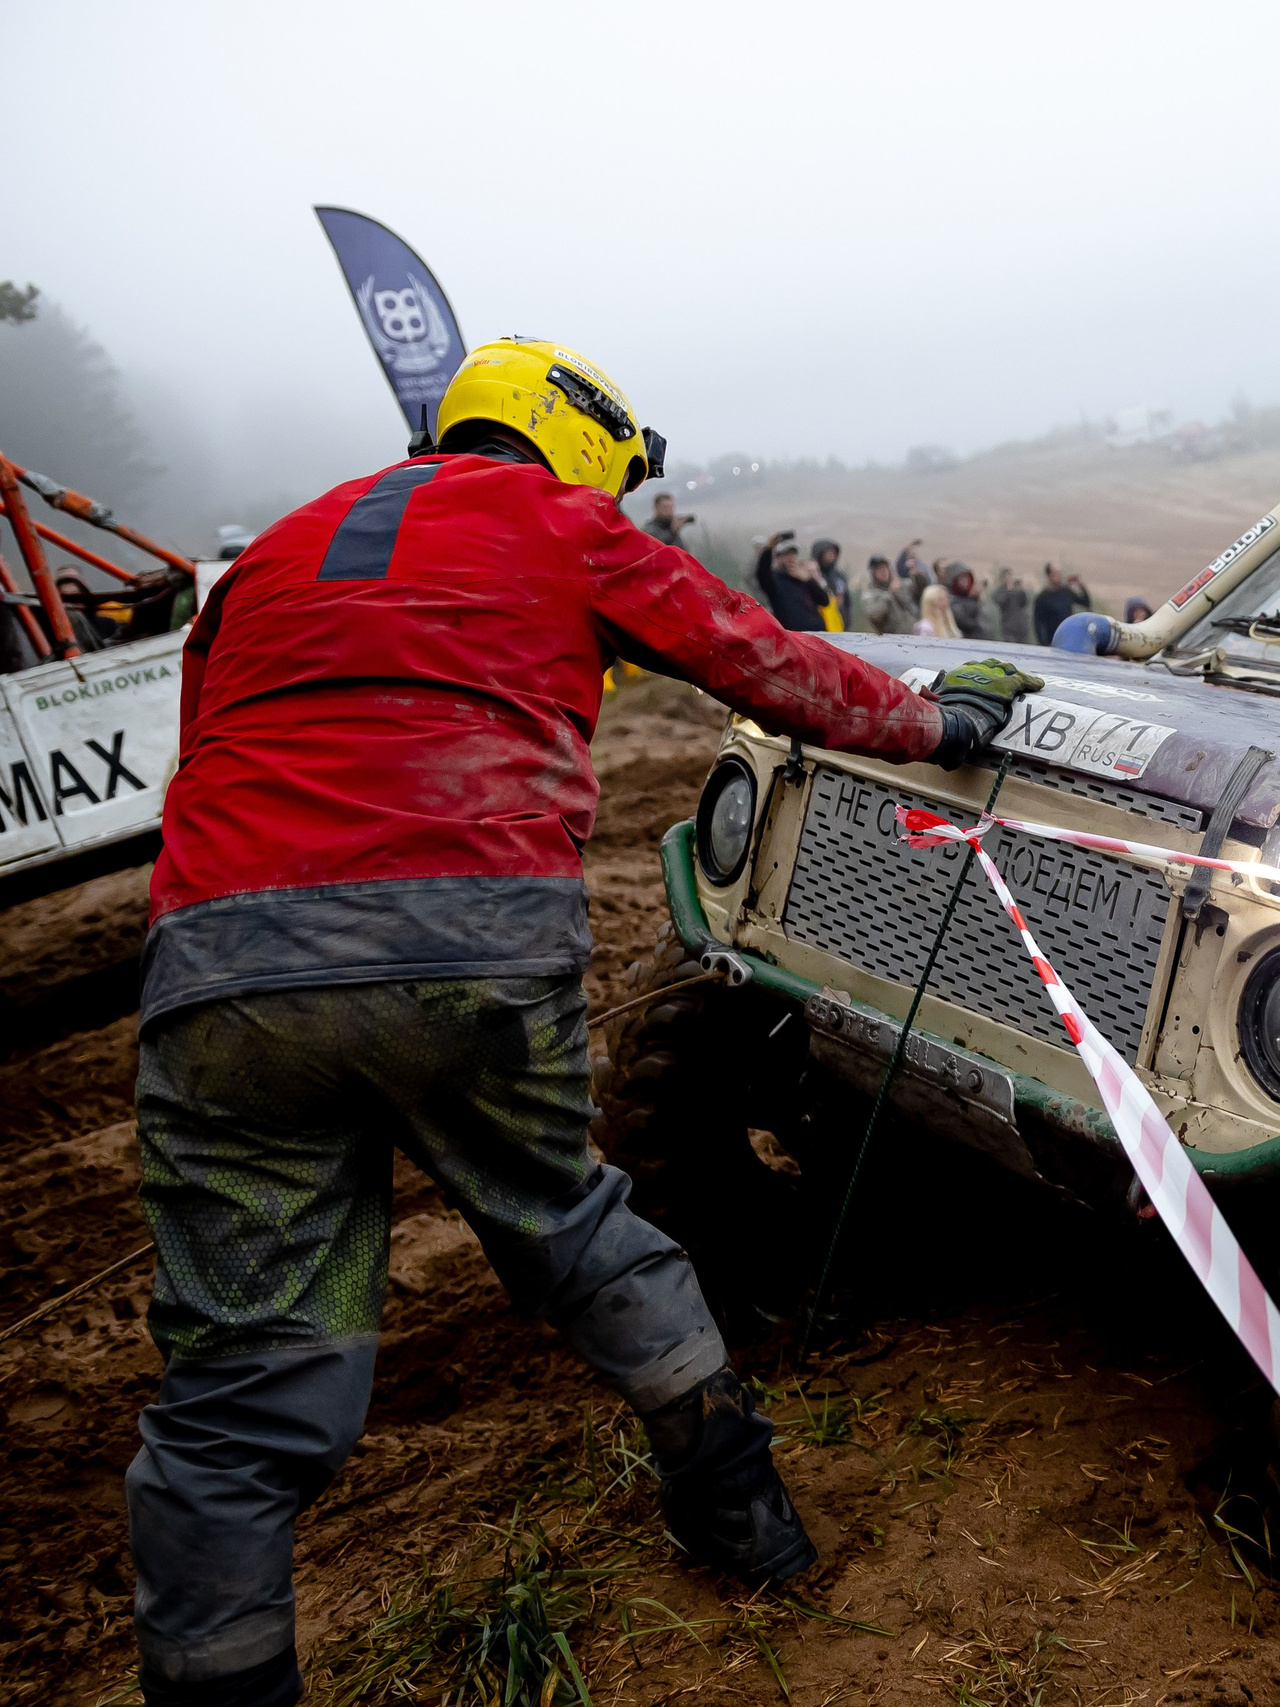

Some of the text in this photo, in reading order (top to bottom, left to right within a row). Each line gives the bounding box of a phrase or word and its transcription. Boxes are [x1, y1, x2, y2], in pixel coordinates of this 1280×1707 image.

[1077, 744, 1116, 767] RUS
[1097, 717, 1152, 752] 71
[0, 730, 148, 833] MAX
[835, 782, 872, 828] НЕ
[985, 839, 1121, 920] ДОЕДЕМ
